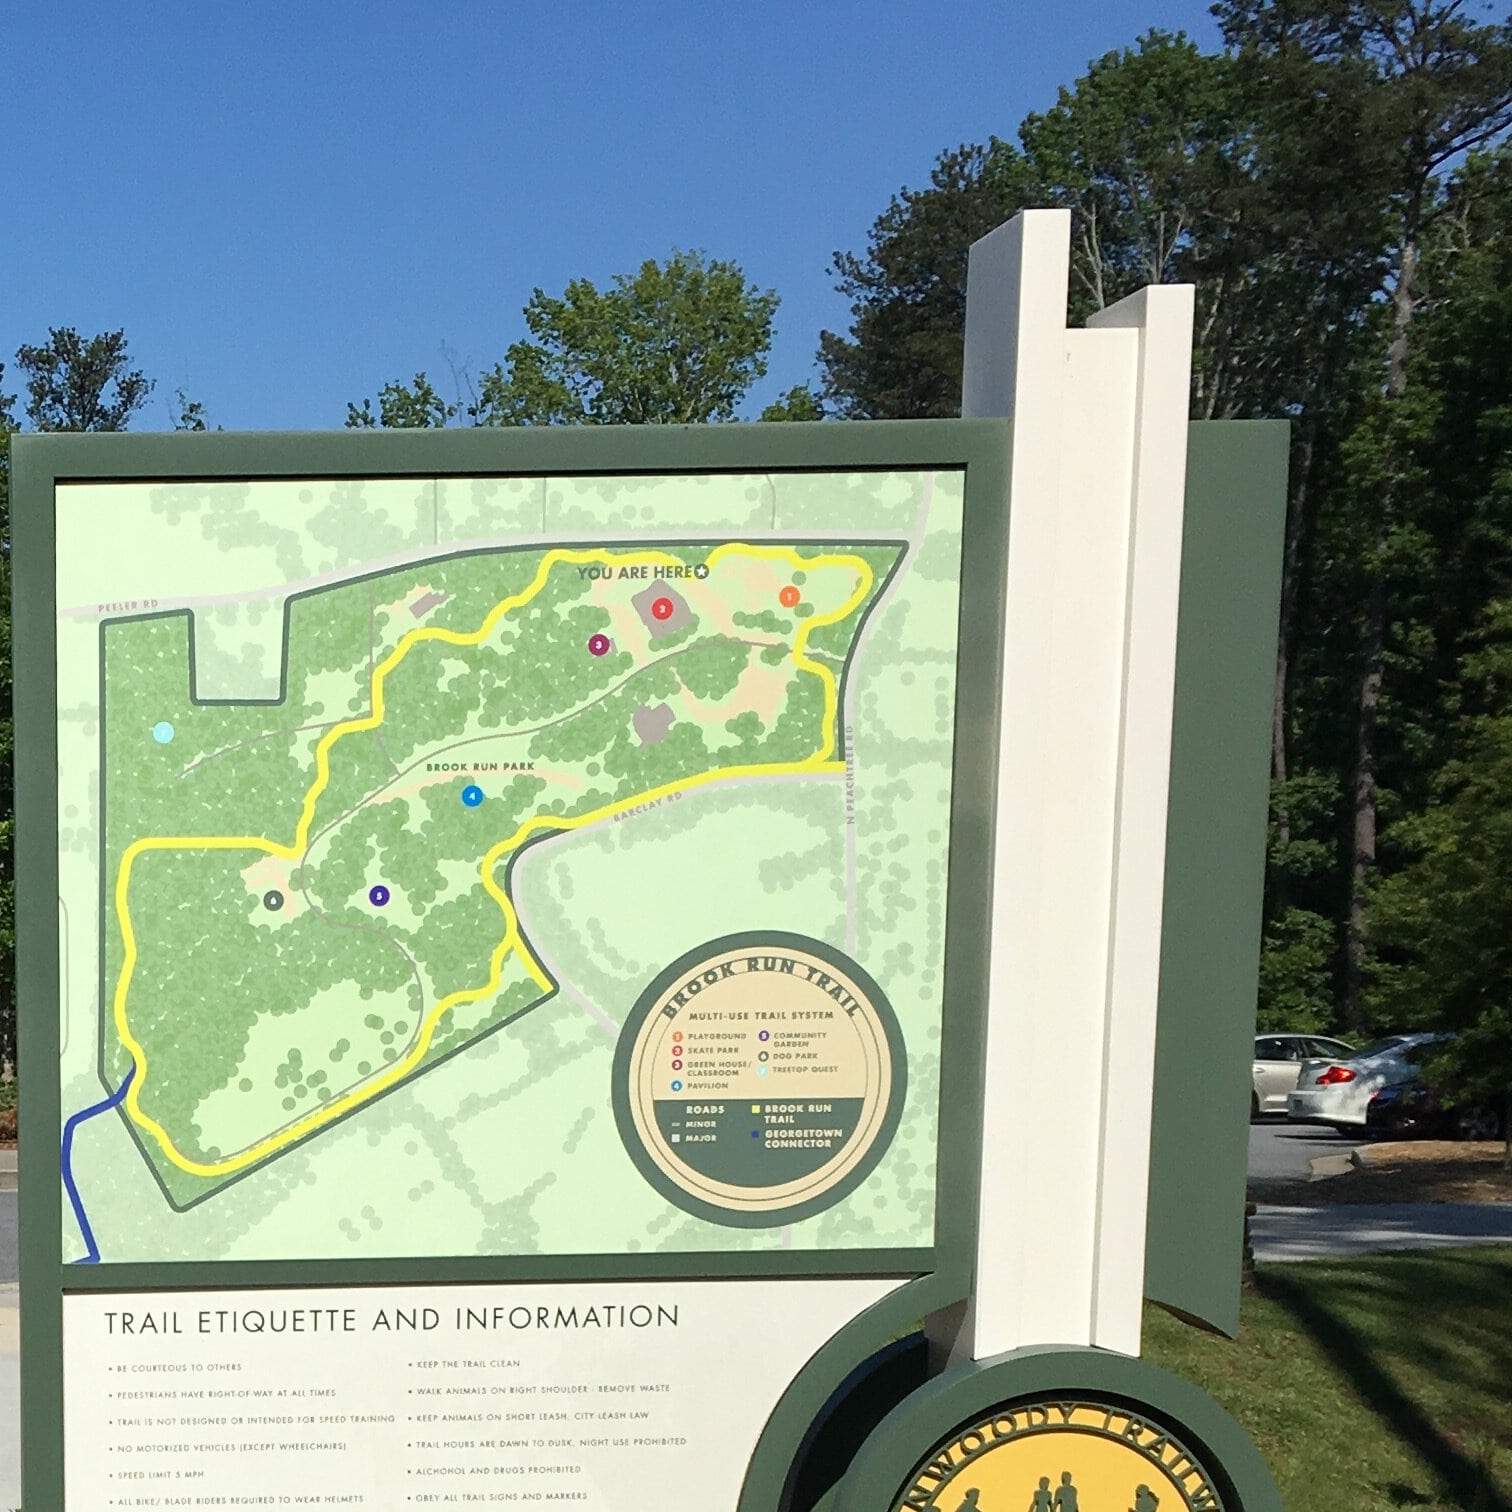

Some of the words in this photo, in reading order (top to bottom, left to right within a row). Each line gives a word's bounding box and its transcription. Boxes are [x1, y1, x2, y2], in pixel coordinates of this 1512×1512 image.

[576, 565, 613, 581] YOU
[618, 565, 648, 580] ARE
[653, 564, 693, 579] HERE
[98, 601, 138, 612] PEELER
[143, 599, 159, 609] RD
[426, 763, 468, 772] BROOK
[473, 763, 498, 772] RUN
[503, 761, 536, 771] PARK
[612, 799, 663, 823] BARCLAY
[667, 791, 683, 803] RD
[660, 960, 737, 1021] BROOK
[746, 956, 796, 975] RUN
[805, 966, 863, 1018] TRAIL
[689, 1012, 750, 1021] MULTI-USE
[754, 1011, 788, 1020] TRAIL
[791, 1011, 834, 1020] SYSTEM
[795, 1052, 819, 1060] PARK
[687, 1061, 716, 1069] GREEN
[686, 1105, 726, 1115] ROADS
[764, 1104, 805, 1114] BROOK
[808, 1104, 833, 1113] RUN
[686, 1120, 717, 1129] MINOR
[764, 1115, 795, 1124] TRAIL
[765, 1128, 843, 1138] GEORGETOWN
[685, 1134, 717, 1143] MAJOR
[765, 1138, 832, 1148] CONNECTOR
[104, 1312, 183, 1335] TRAIL
[198, 1309, 356, 1334] ETIQUETTE
[373, 1308, 441, 1331] AND
[456, 1304, 680, 1331] INFORMATION
[117, 1364, 128, 1373] BE
[132, 1364, 188, 1373] COURTEOUS
[191, 1363, 204, 1372] TO
[207, 1363, 242, 1372] OTHERS
[417, 1360, 439, 1369] KEEP
[442, 1360, 459, 1369] THE
[462, 1360, 487, 1369] TRAIL
[490, 1359, 521, 1368] CLEAN
[117, 1390, 178, 1400] PEDESTRIANS
[181, 1390, 205, 1399] HAVE
[277, 1389, 288, 1398] AT
[292, 1389, 306, 1398] ALL
[310, 1389, 336, 1398] TIMES
[417, 1387, 442, 1396] WALK
[446, 1386, 487, 1396] ANIMALS
[491, 1386, 506, 1395] ON
[510, 1386, 537, 1395] RIGHT
[541, 1385, 588, 1394] SHOULDER
[598, 1385, 636, 1394] REMOVE
[640, 1384, 671, 1393] WASTE
[118, 1418, 141, 1427] TRAIL
[144, 1417, 153, 1426] IS
[157, 1417, 177, 1426] NOT
[180, 1417, 227, 1426] DESIGNED
[230, 1416, 244, 1425] OR
[248, 1416, 294, 1425] INTENDED
[298, 1416, 315, 1425] FOR
[319, 1415, 346, 1424] SPEED
[350, 1415, 396, 1424] TRAINING
[416, 1414, 439, 1423] KEEP
[442, 1413, 483, 1422] ANIMALS
[487, 1413, 502, 1422] ON
[506, 1412, 535, 1422] SHORT
[574, 1412, 595, 1421] CITY
[598, 1411, 626, 1420] LEASH
[630, 1411, 650, 1420] LAW
[118, 1444, 133, 1453] NO
[136, 1444, 190, 1453] MOTORIZED
[194, 1443, 236, 1453] VEHICLES
[416, 1440, 440, 1449] TRAIL
[444, 1440, 475, 1449] HOURS
[479, 1440, 496, 1449] ARE
[499, 1439, 529, 1448] DAWN
[532, 1439, 545, 1448] TO
[580, 1438, 609, 1447] NIGHT
[613, 1438, 630, 1447] USE
[633, 1437, 687, 1447] PROHIBITED
[118, 1471, 145, 1480] SPEED
[149, 1470, 172, 1480] LIMIT
[184, 1470, 204, 1479] MPH
[416, 1467, 466, 1476] ALCHOHOL
[470, 1466, 490, 1475] AND
[493, 1466, 525, 1475] DRUGS
[528, 1465, 582, 1475] PROHIBITED
[118, 1498, 133, 1507] ALL
[165, 1497, 193, 1506] BLADE
[196, 1497, 227, 1506] RIDERS
[230, 1496, 275, 1505] REQUIRED
[278, 1496, 291, 1505] TO
[294, 1495, 321, 1504] WEAR
[324, 1495, 364, 1504] HELMETS
[416, 1494, 440, 1503] OBEY
[444, 1493, 458, 1502] ALL
[462, 1493, 486, 1502] TRAIL
[489, 1493, 518, 1502] SIGNS
[522, 1492, 542, 1501] AND
[546, 1492, 588, 1501] MARKERS
